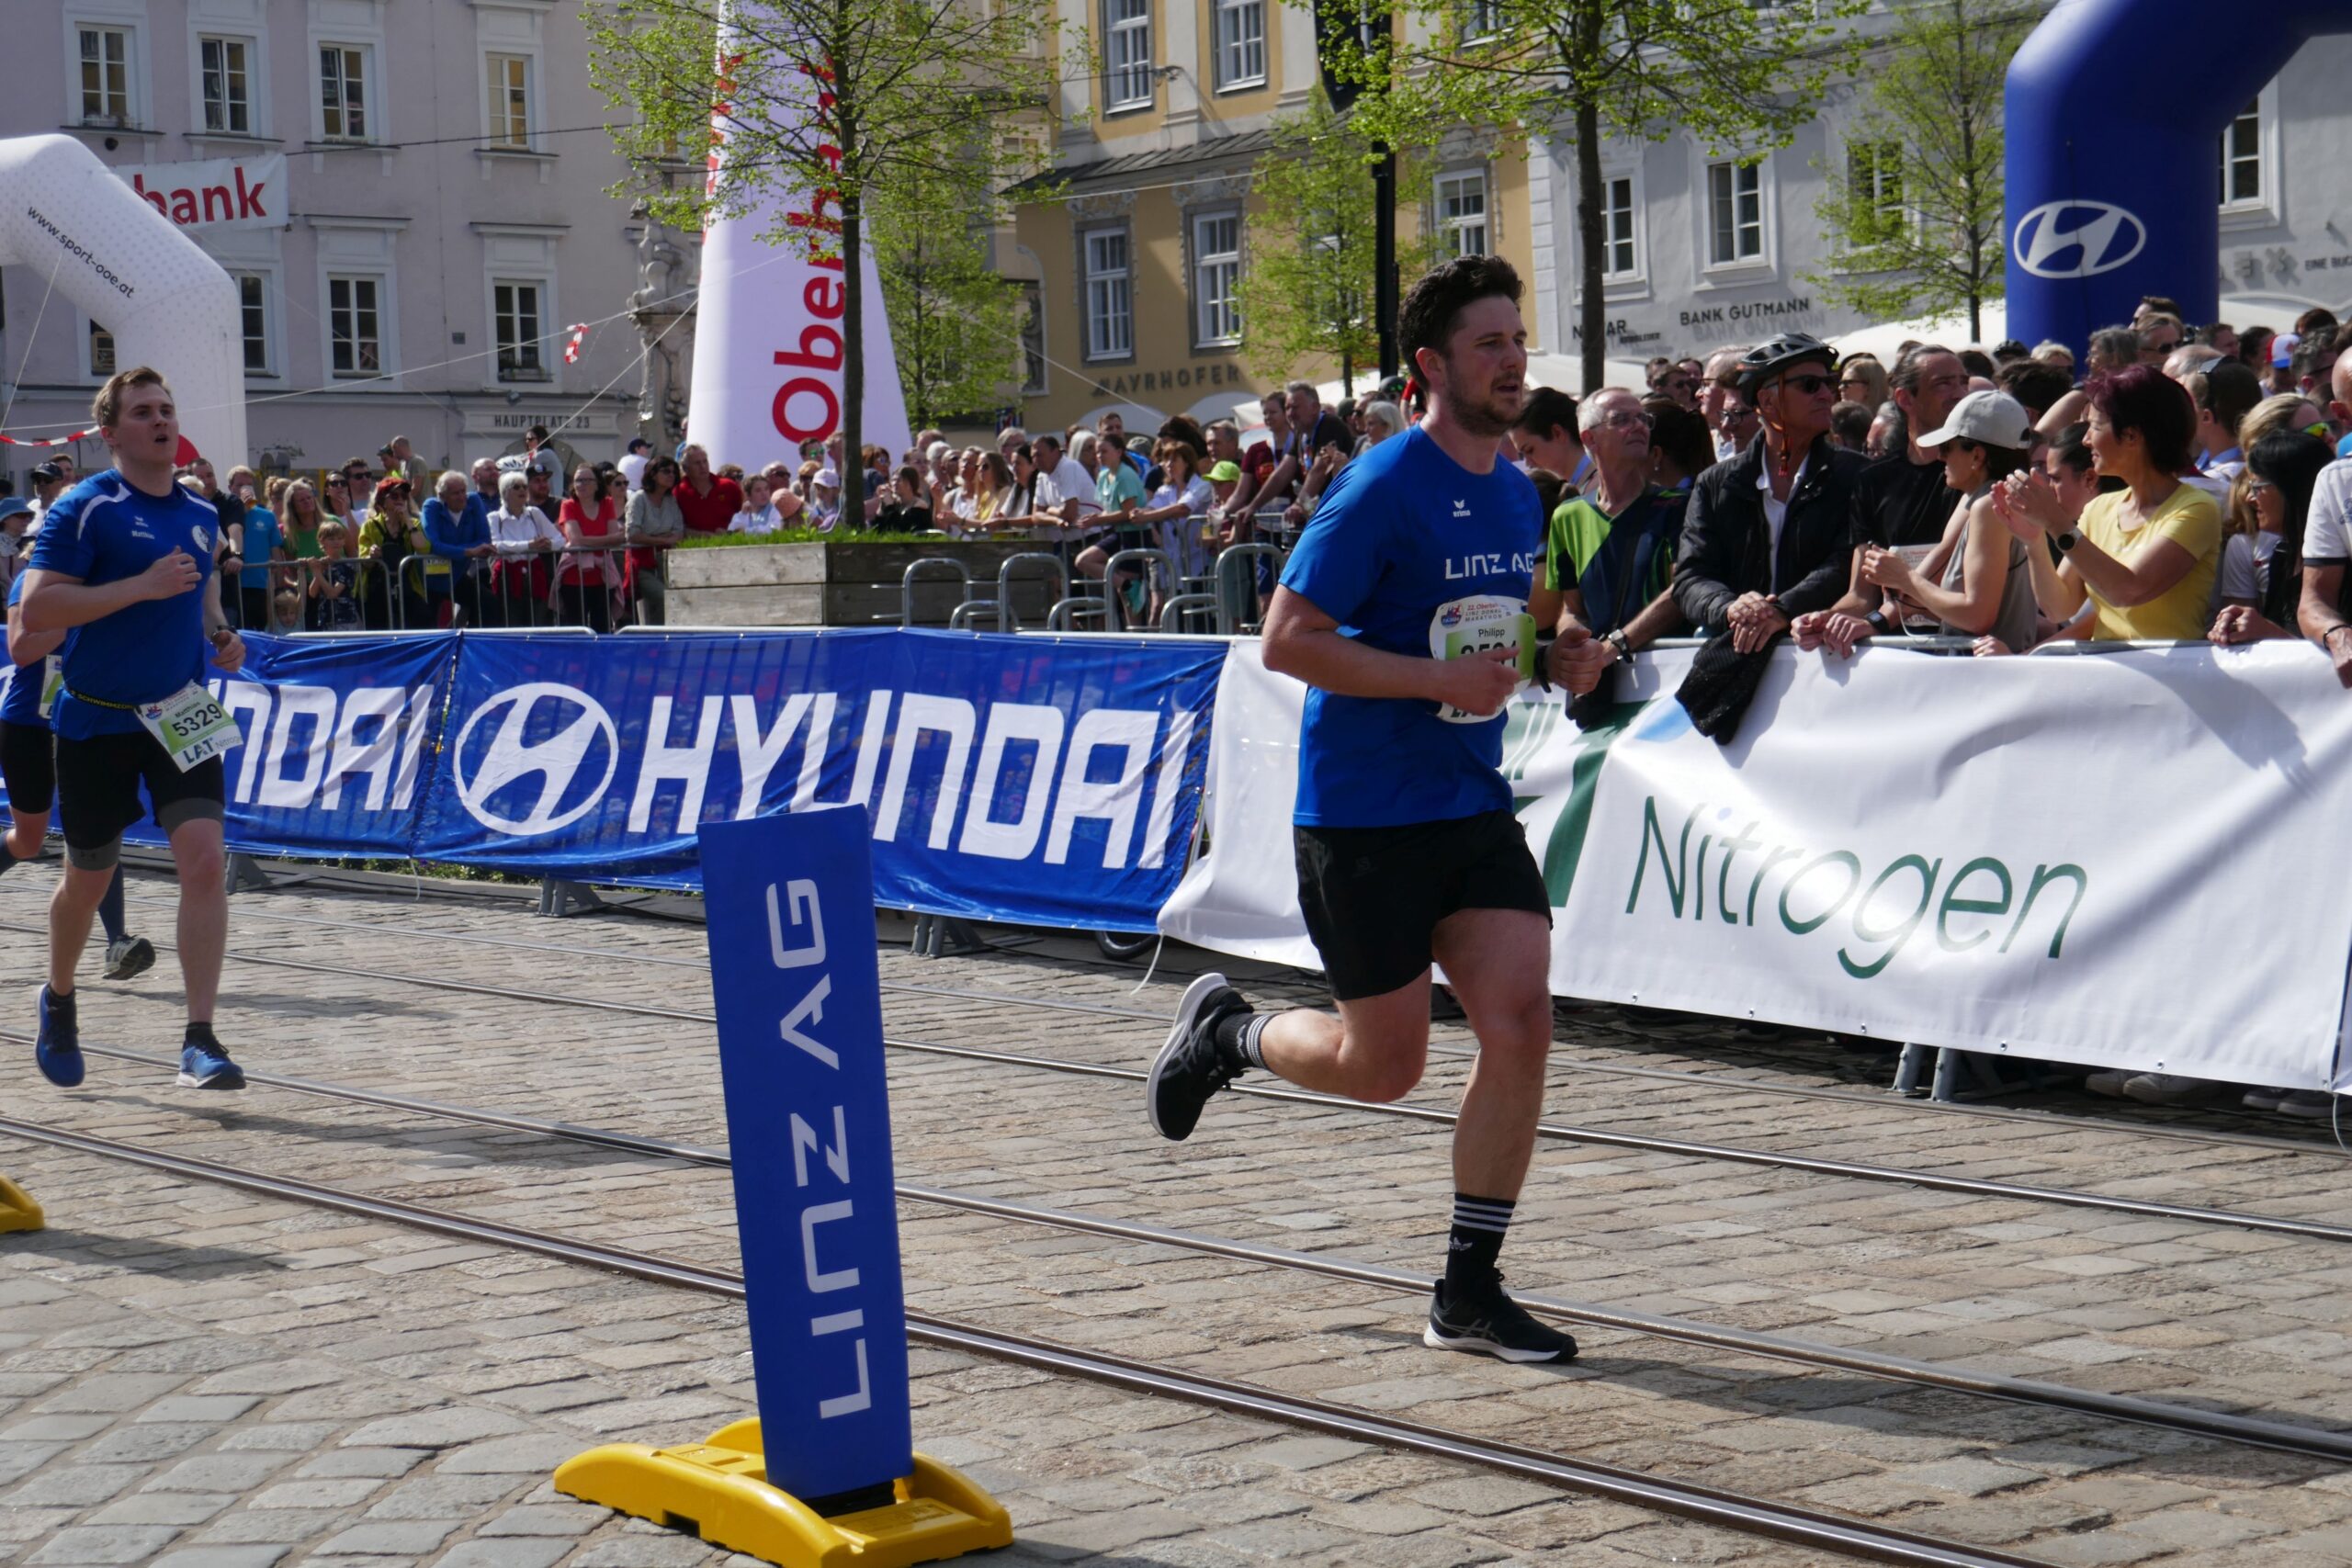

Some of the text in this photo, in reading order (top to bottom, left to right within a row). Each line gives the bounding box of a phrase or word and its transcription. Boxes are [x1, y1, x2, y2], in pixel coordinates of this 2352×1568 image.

[27, 206, 135, 299] www.sport-ooe.at
[1679, 298, 1809, 326] BANK GUTMANN
[1573, 320, 1627, 340] NAR
[1092, 364, 1239, 397] MAYRHOFER
[494, 415, 590, 428] HAUPTPLATZ 23
[1445, 553, 1507, 580] LINZ
[1478, 628, 1506, 638] Philipp
[172, 703, 222, 737] 5329
[628, 689, 1198, 869] HYUNDAI
[1625, 795, 2088, 980] Nitrogen
[766, 878, 872, 1419] LINZ AG
